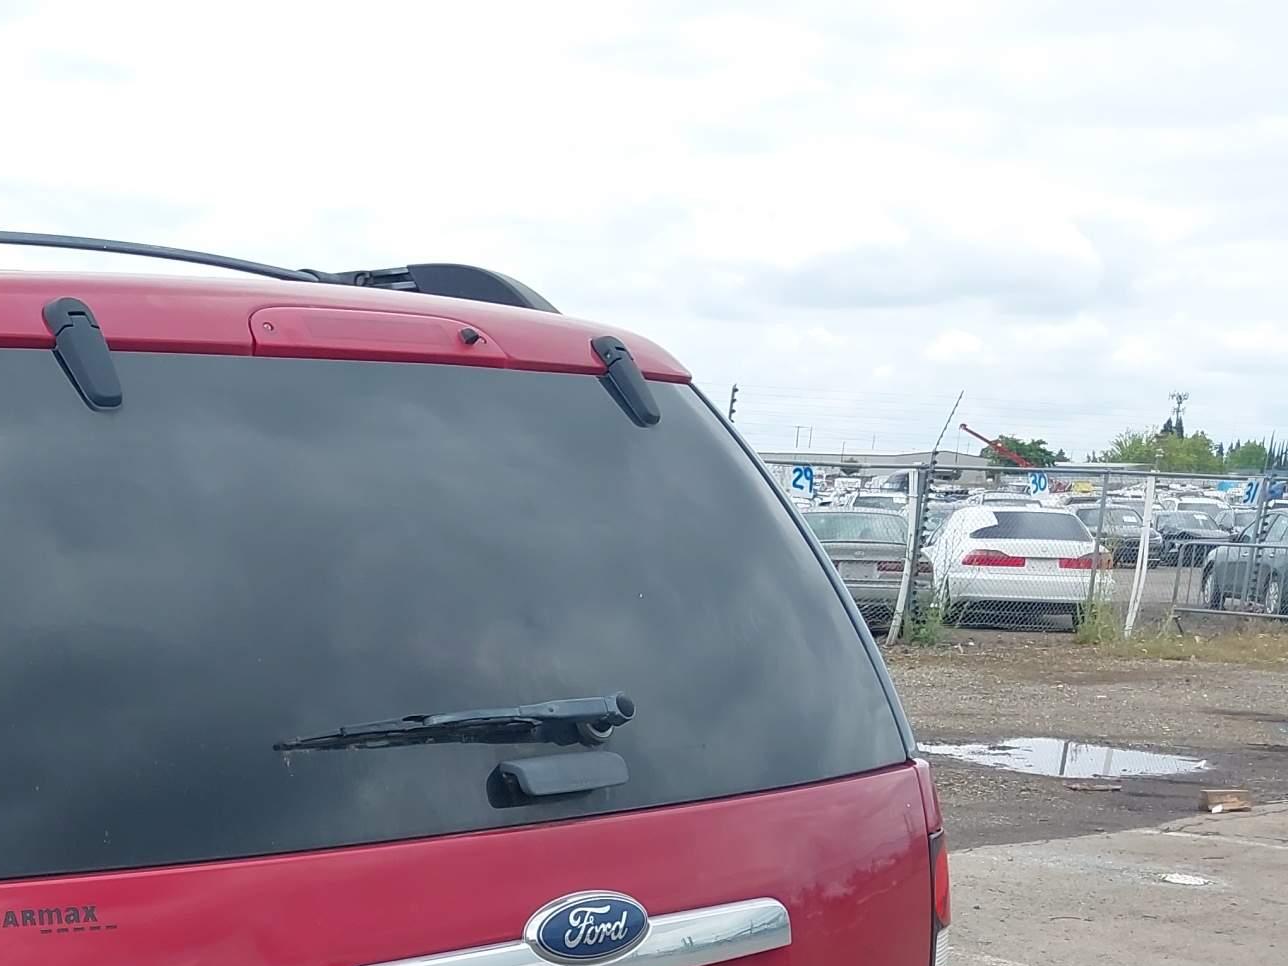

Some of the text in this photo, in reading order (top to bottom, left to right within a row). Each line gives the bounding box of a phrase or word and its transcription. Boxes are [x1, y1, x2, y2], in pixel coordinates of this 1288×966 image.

[792, 467, 814, 494] 29
[1030, 472, 1048, 494] 30
[1242, 481, 1261, 504] 31
[565, 904, 629, 949] Ford
